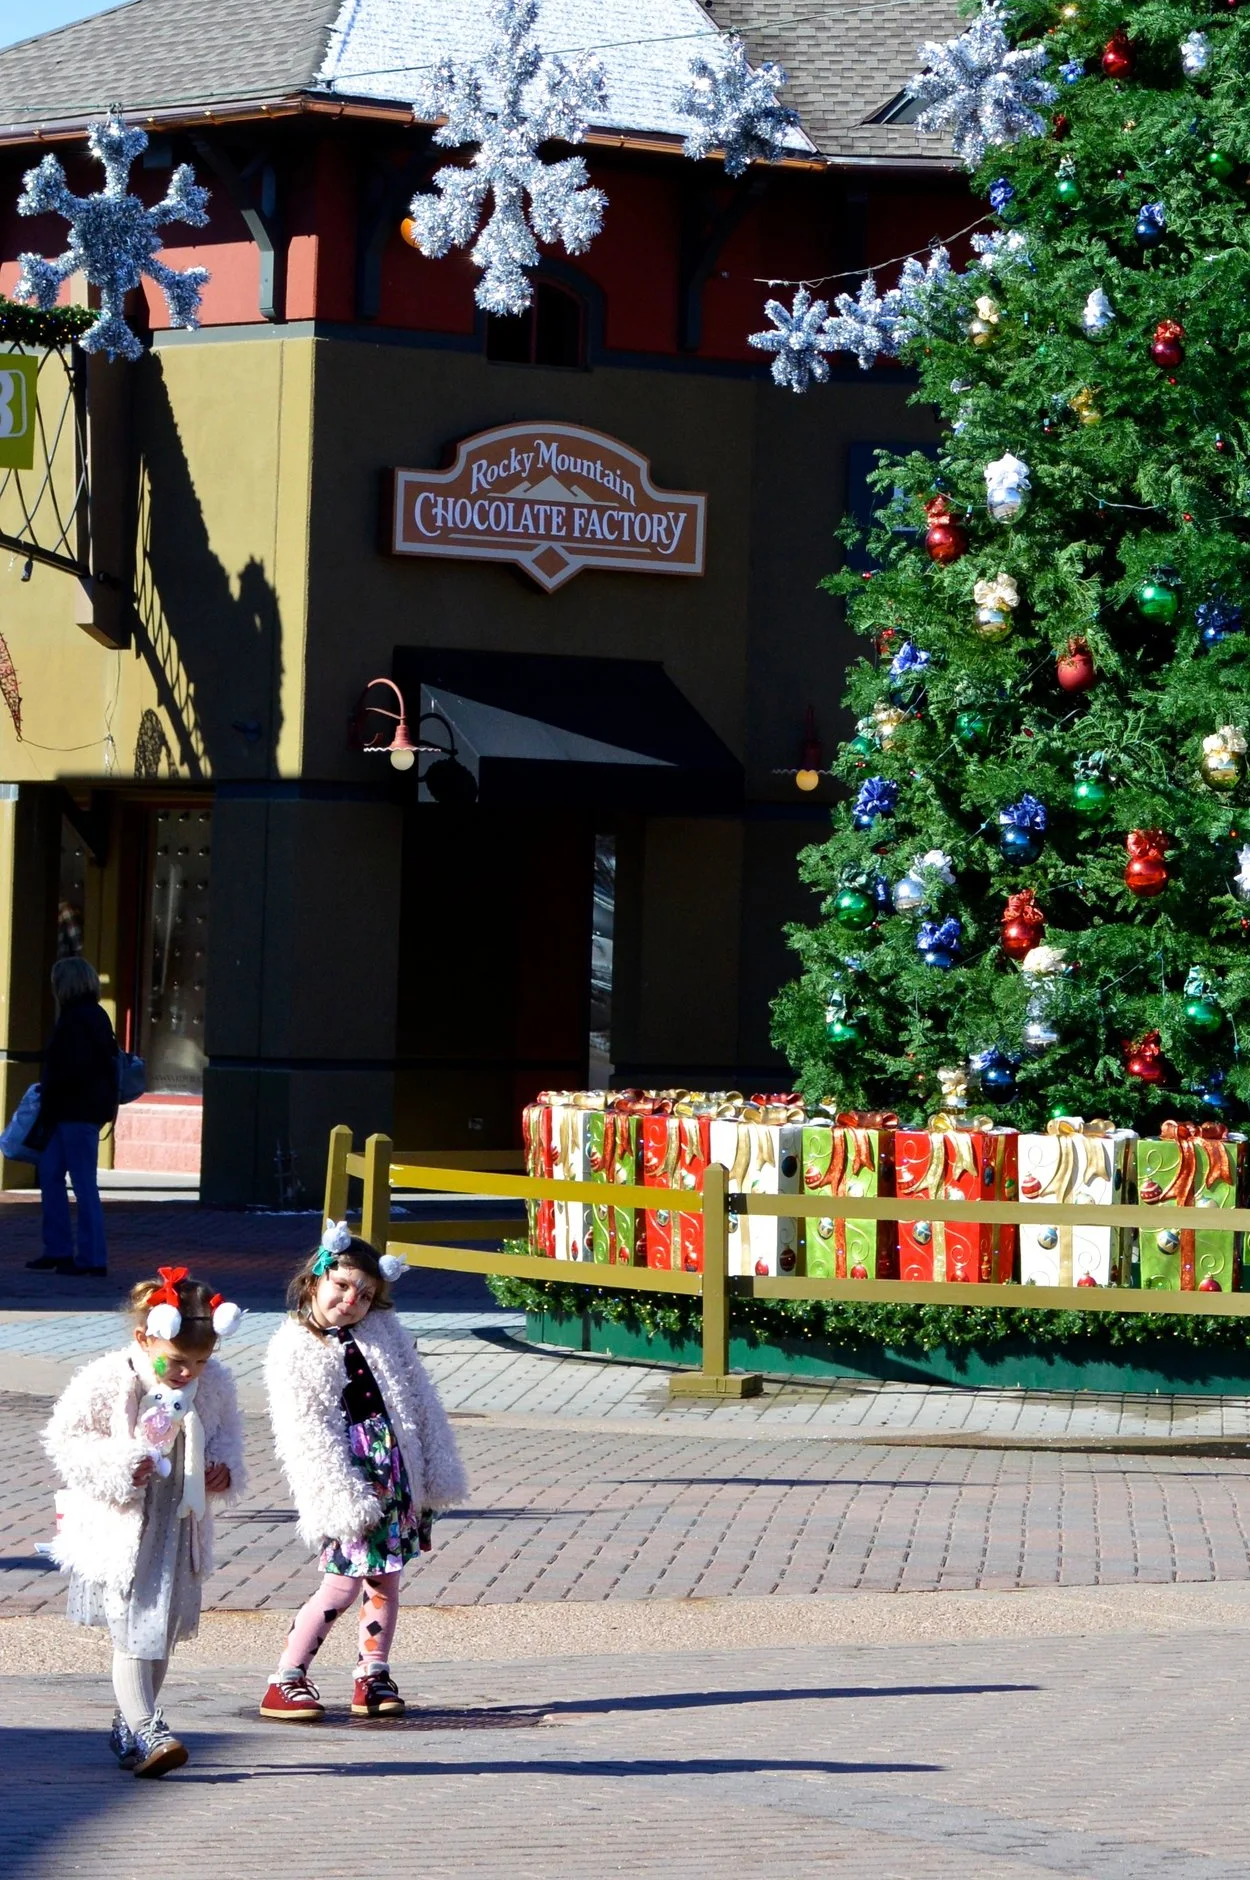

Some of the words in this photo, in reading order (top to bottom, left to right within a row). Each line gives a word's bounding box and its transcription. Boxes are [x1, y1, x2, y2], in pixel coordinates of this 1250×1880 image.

[471, 448, 535, 493] Rocky
[534, 439, 637, 506] Mountain
[414, 492, 566, 537] CHOCOLATE
[573, 508, 687, 555] FACTORY
